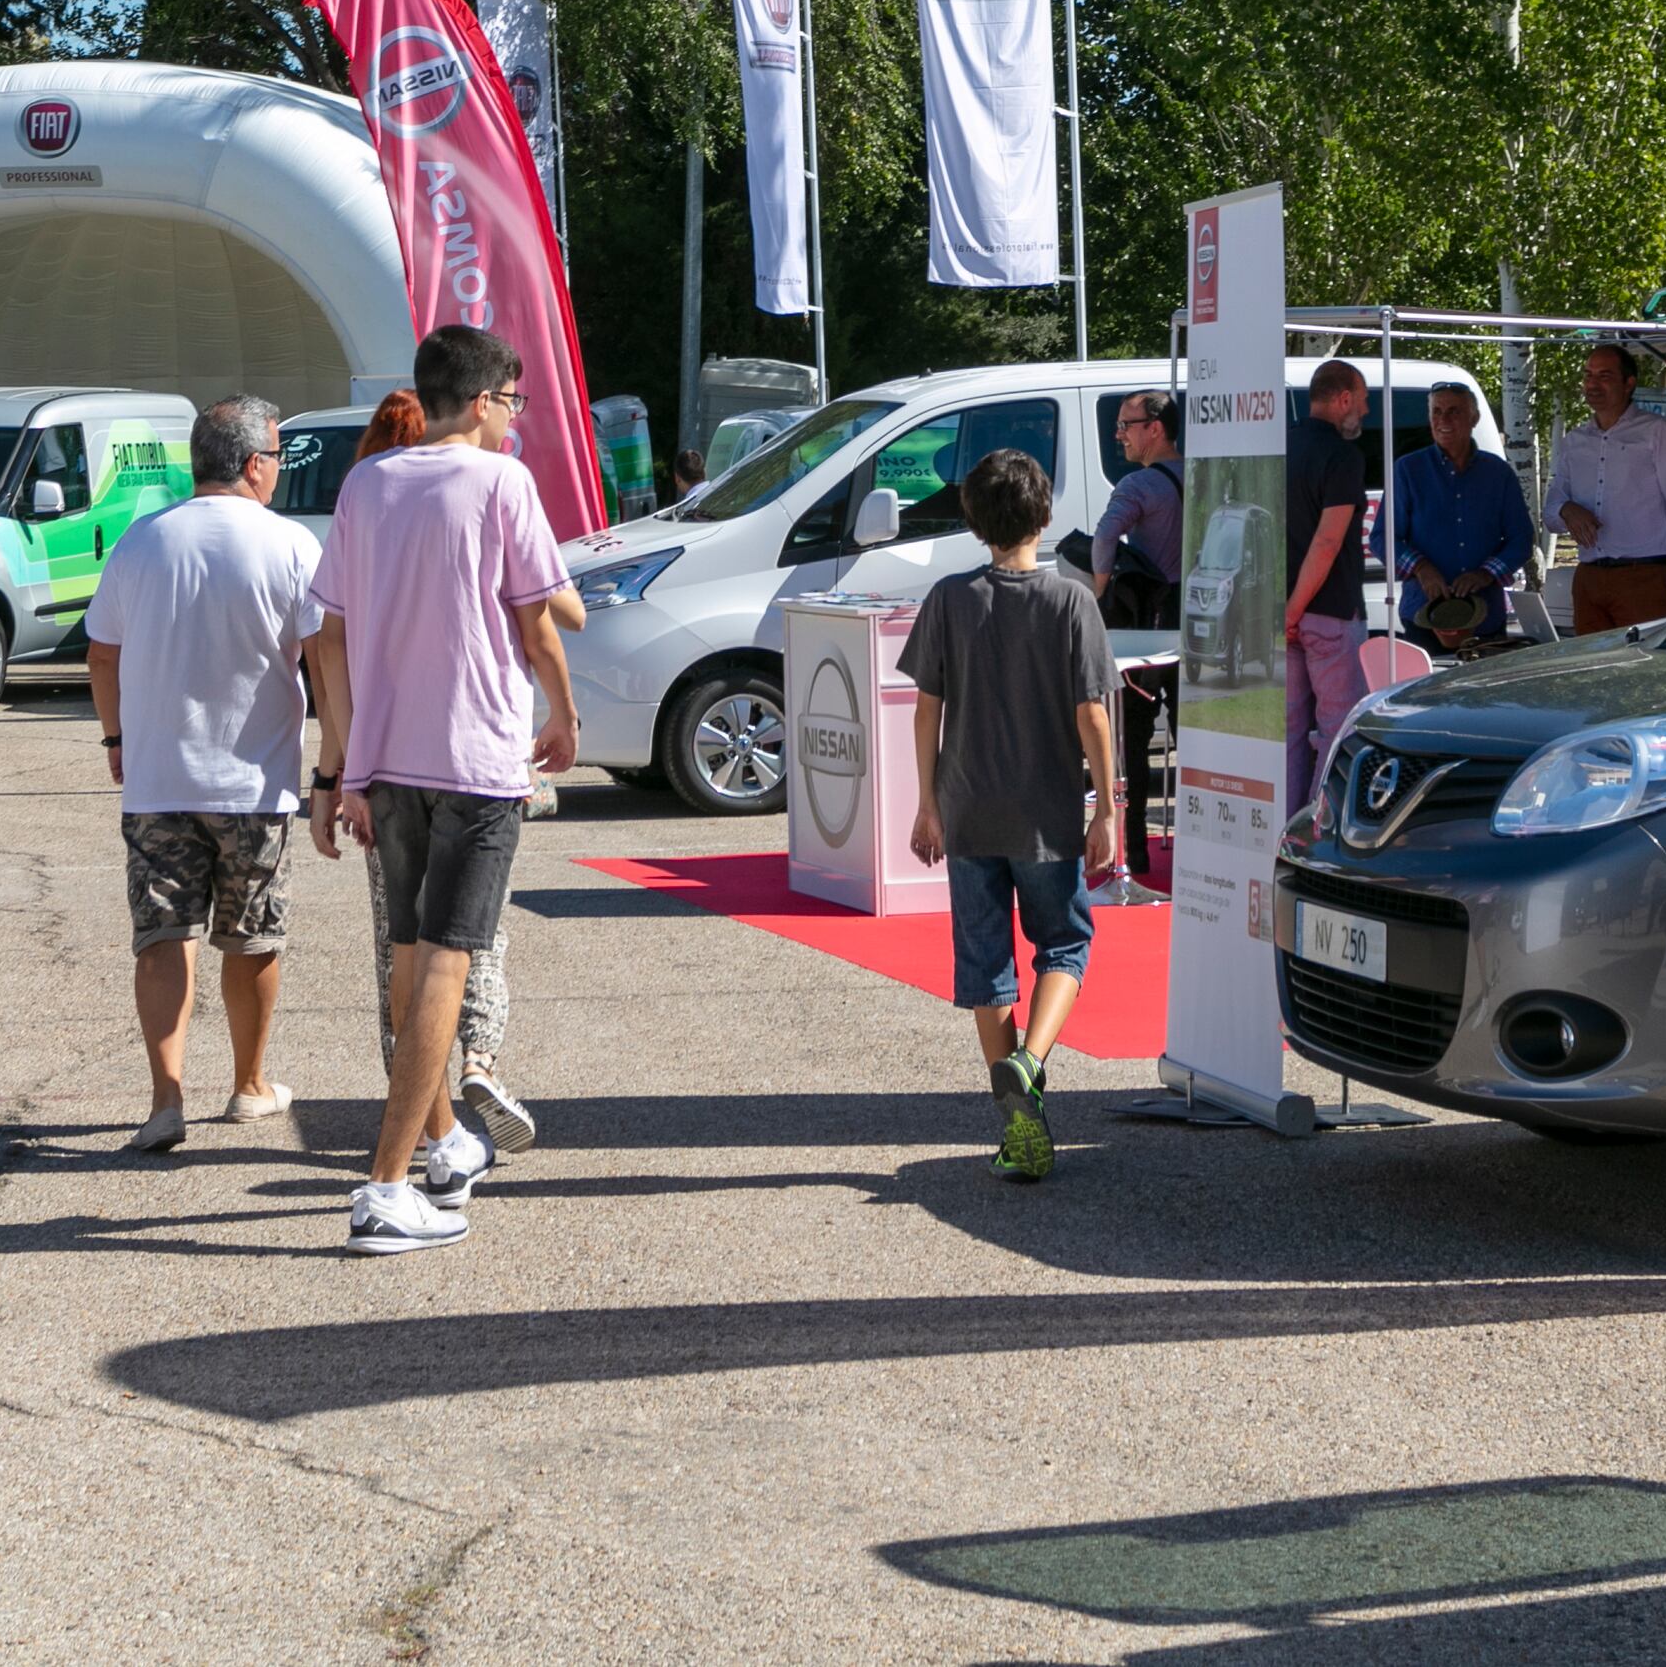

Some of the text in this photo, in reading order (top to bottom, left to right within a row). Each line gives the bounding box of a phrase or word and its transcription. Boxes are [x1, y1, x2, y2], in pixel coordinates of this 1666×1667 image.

[31, 111, 68, 140] FIAT
[6, 171, 96, 183] PROFESSIONAL
[1189, 390, 1275, 425] NISSAN NV250
[113, 443, 134, 472] FIAT
[287, 434, 312, 452] 5
[804, 727, 860, 763] NISSAN
[1188, 795, 1199, 815] 59
[1218, 801, 1229, 822] 70
[1315, 918, 1367, 965] NV 250
